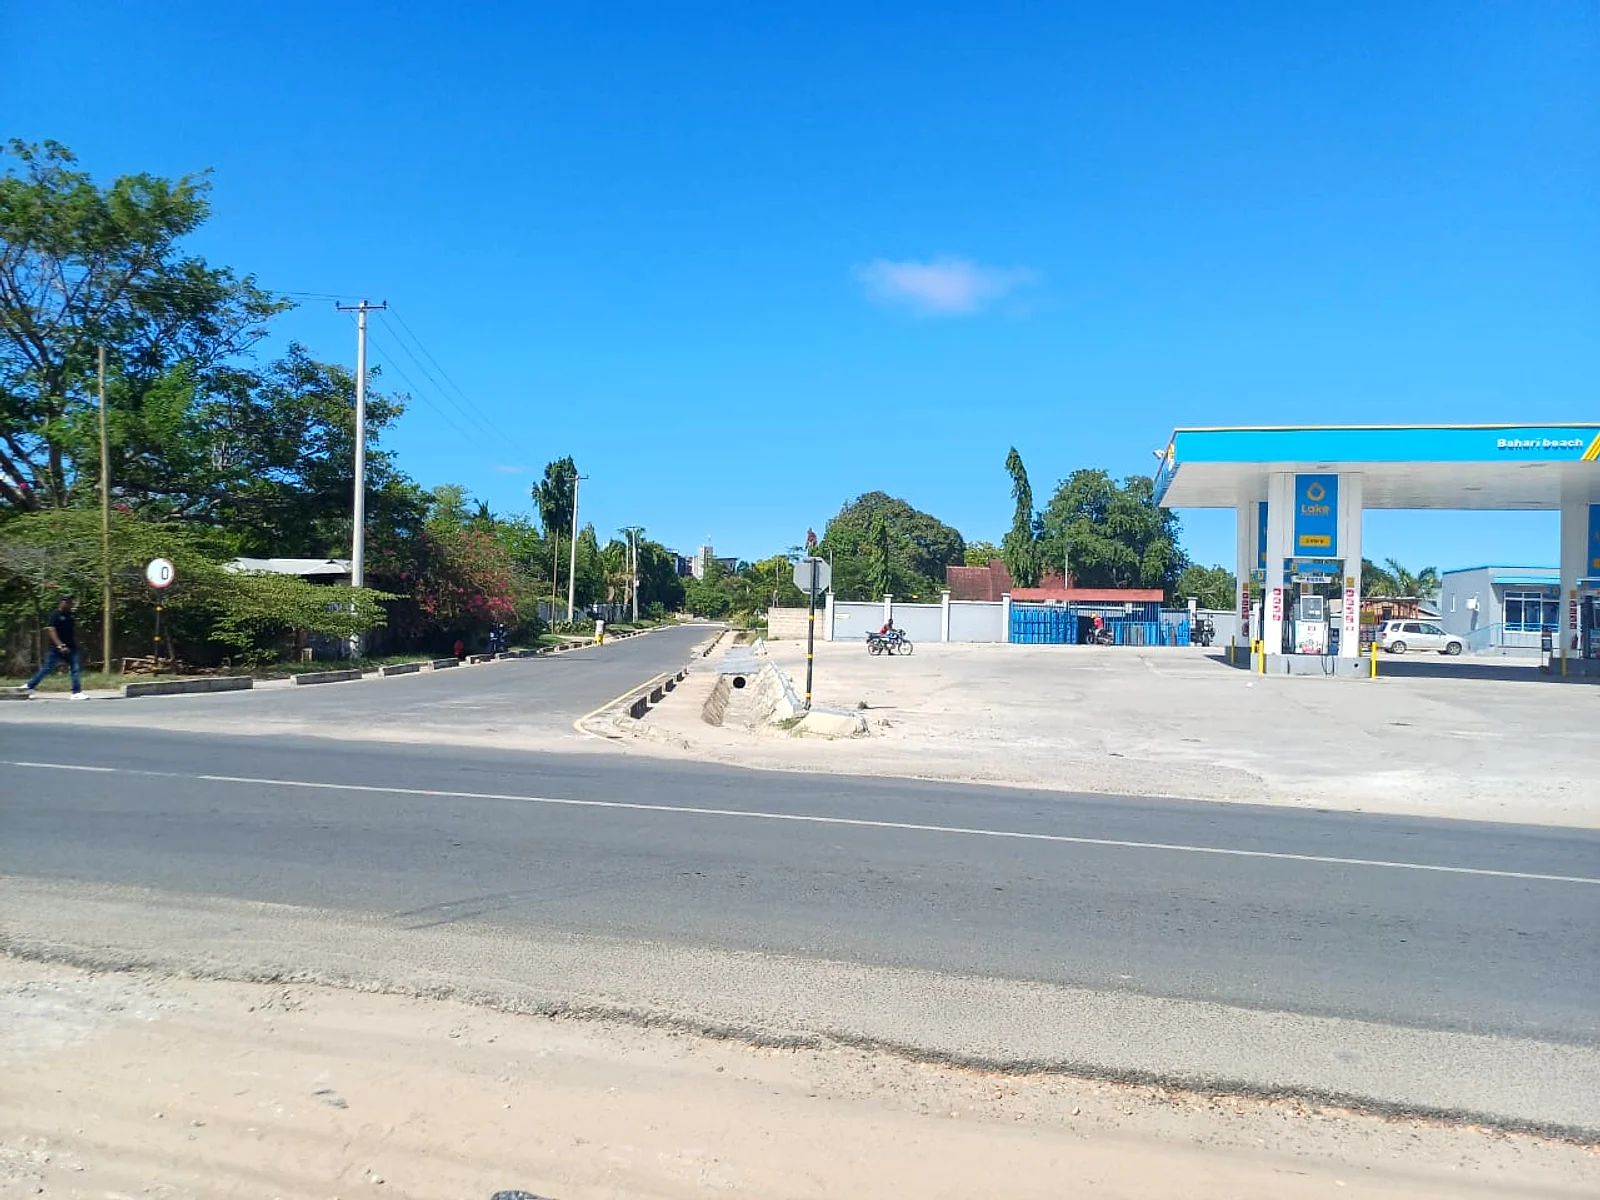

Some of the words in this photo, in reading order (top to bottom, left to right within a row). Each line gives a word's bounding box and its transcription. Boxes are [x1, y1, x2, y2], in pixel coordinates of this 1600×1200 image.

[1497, 437, 1540, 448] Bahari
[1543, 438, 1583, 448] beach
[1301, 503, 1329, 514] Lake
